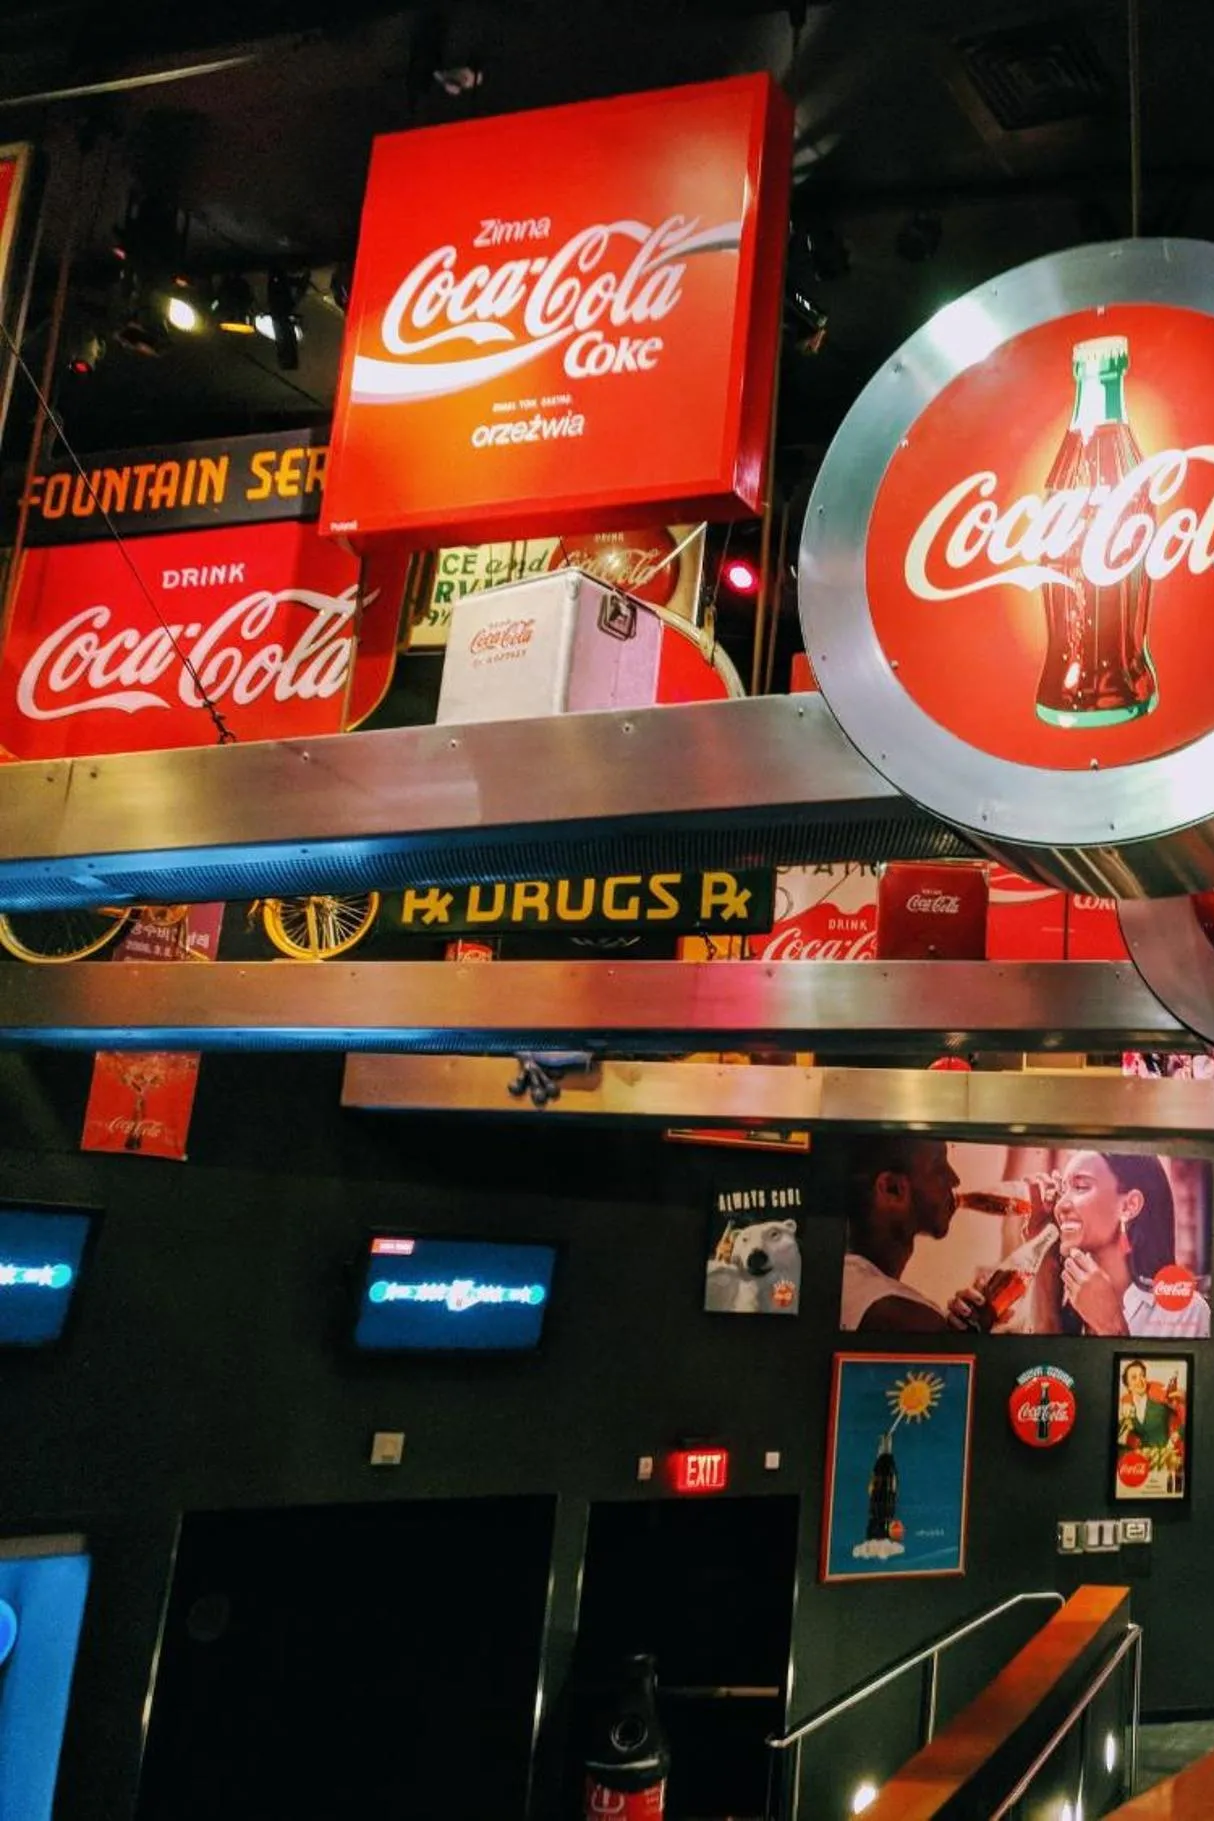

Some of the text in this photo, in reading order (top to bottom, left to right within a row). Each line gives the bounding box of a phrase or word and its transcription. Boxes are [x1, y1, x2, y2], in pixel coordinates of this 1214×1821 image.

[473, 216, 551, 248] Zimna
[380, 214, 701, 355] Coca-Cola
[563, 331, 664, 380] Coke
[19, 454, 230, 520] FOUNTAIN
[161, 563, 246, 589] DRINK
[16, 584, 380, 721] Coca-Cola
[466, 873, 683, 923] DRUGS
[905, 894, 962, 913] Coca-Cola
[828, 919, 868, 931] DRINK
[686, 1454, 722, 1488] EXIT
